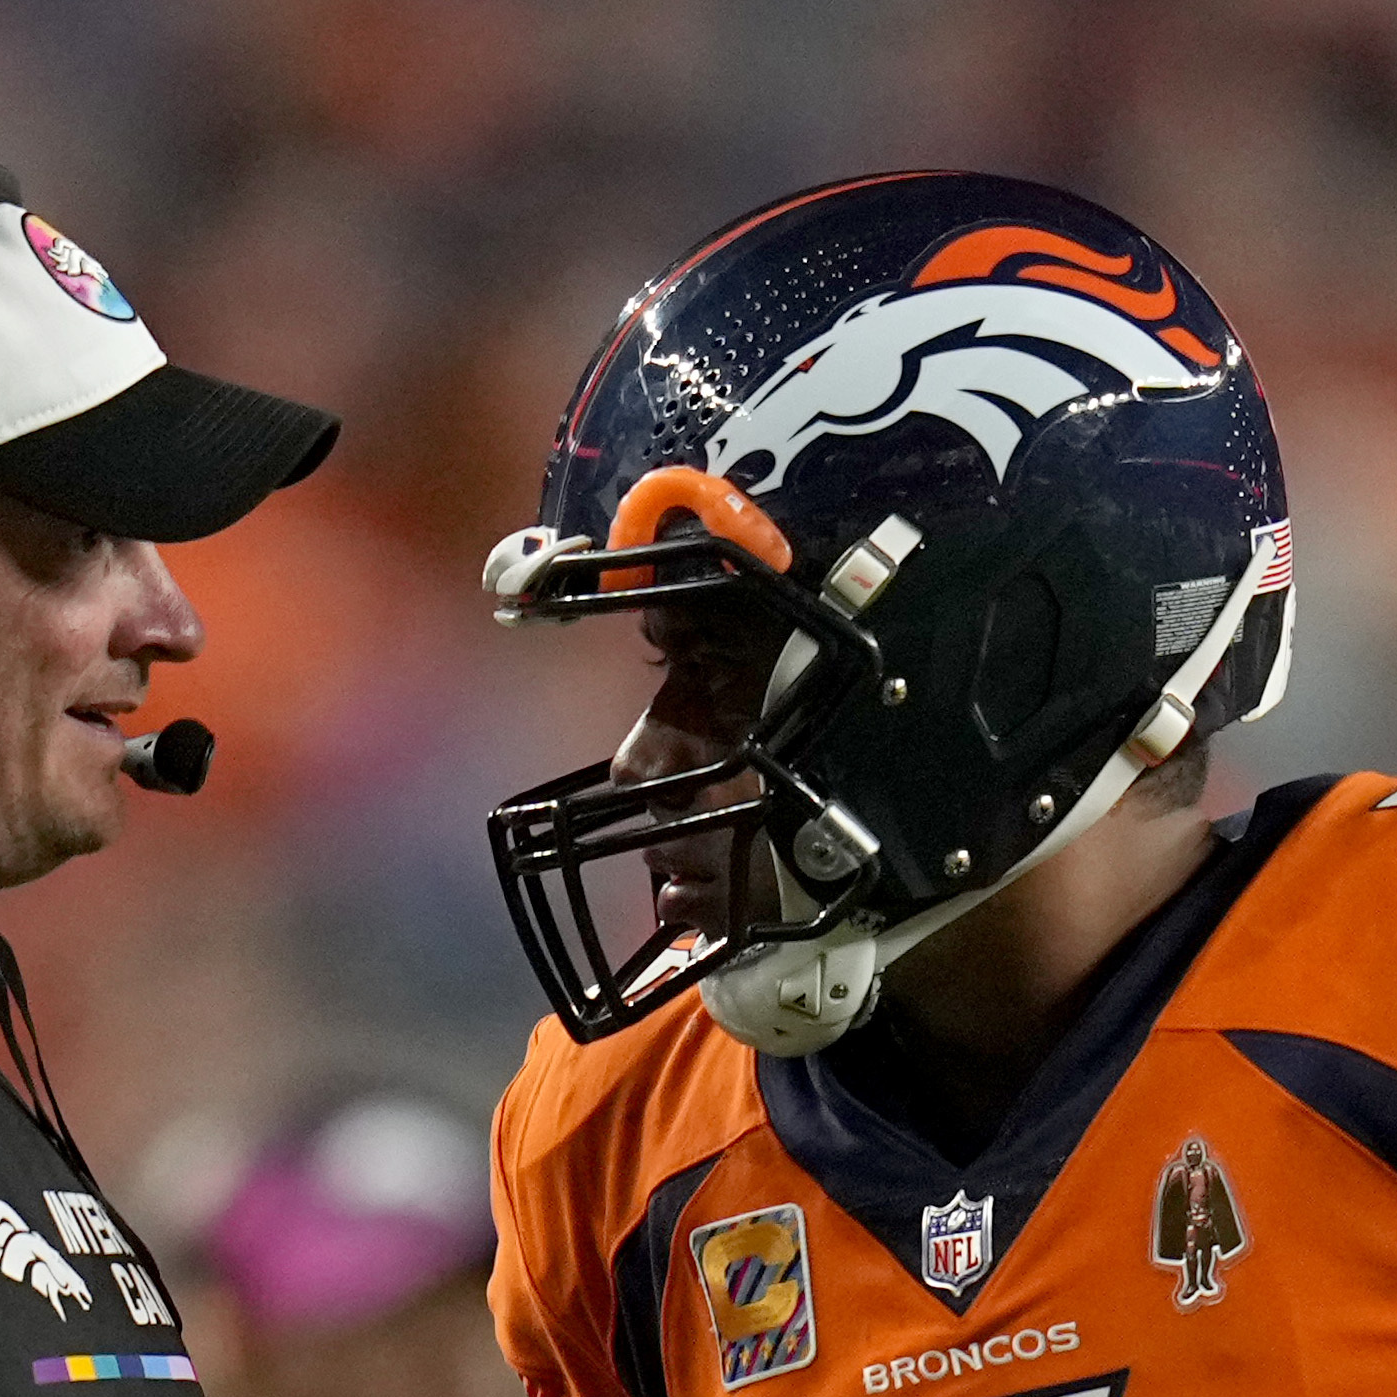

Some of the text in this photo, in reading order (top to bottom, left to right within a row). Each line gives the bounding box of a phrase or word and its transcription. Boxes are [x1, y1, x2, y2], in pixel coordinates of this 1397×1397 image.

[1180, 575, 1227, 590] WARNING
[703, 1219, 800, 1343] C
[933, 1236, 979, 1277] NFL
[862, 1321, 1081, 1396] BRONCOS
